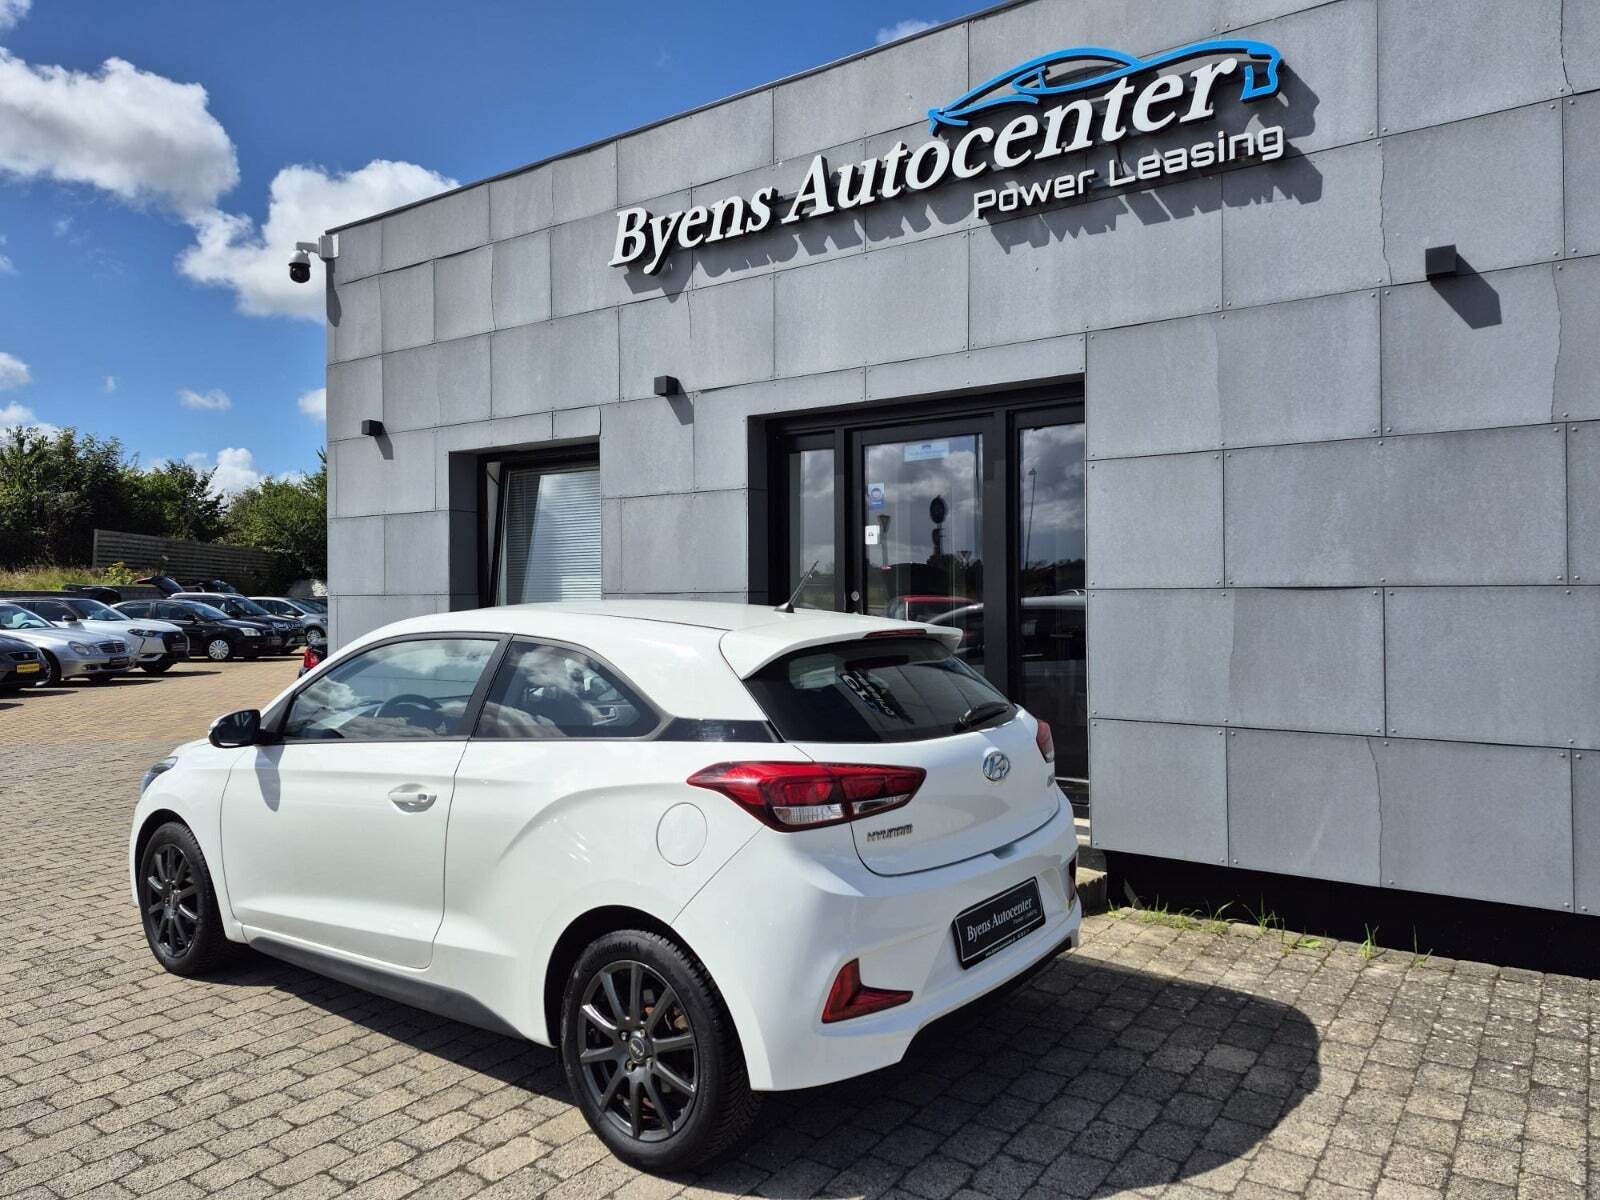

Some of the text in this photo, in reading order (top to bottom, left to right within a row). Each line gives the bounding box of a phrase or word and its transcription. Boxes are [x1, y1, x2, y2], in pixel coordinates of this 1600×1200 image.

[608, 58, 1238, 274] Byens Autocenter
[974, 126, 1285, 219] Power Leasing
[966, 919, 992, 943] Byens
[991, 897, 1033, 929] Autocenter
